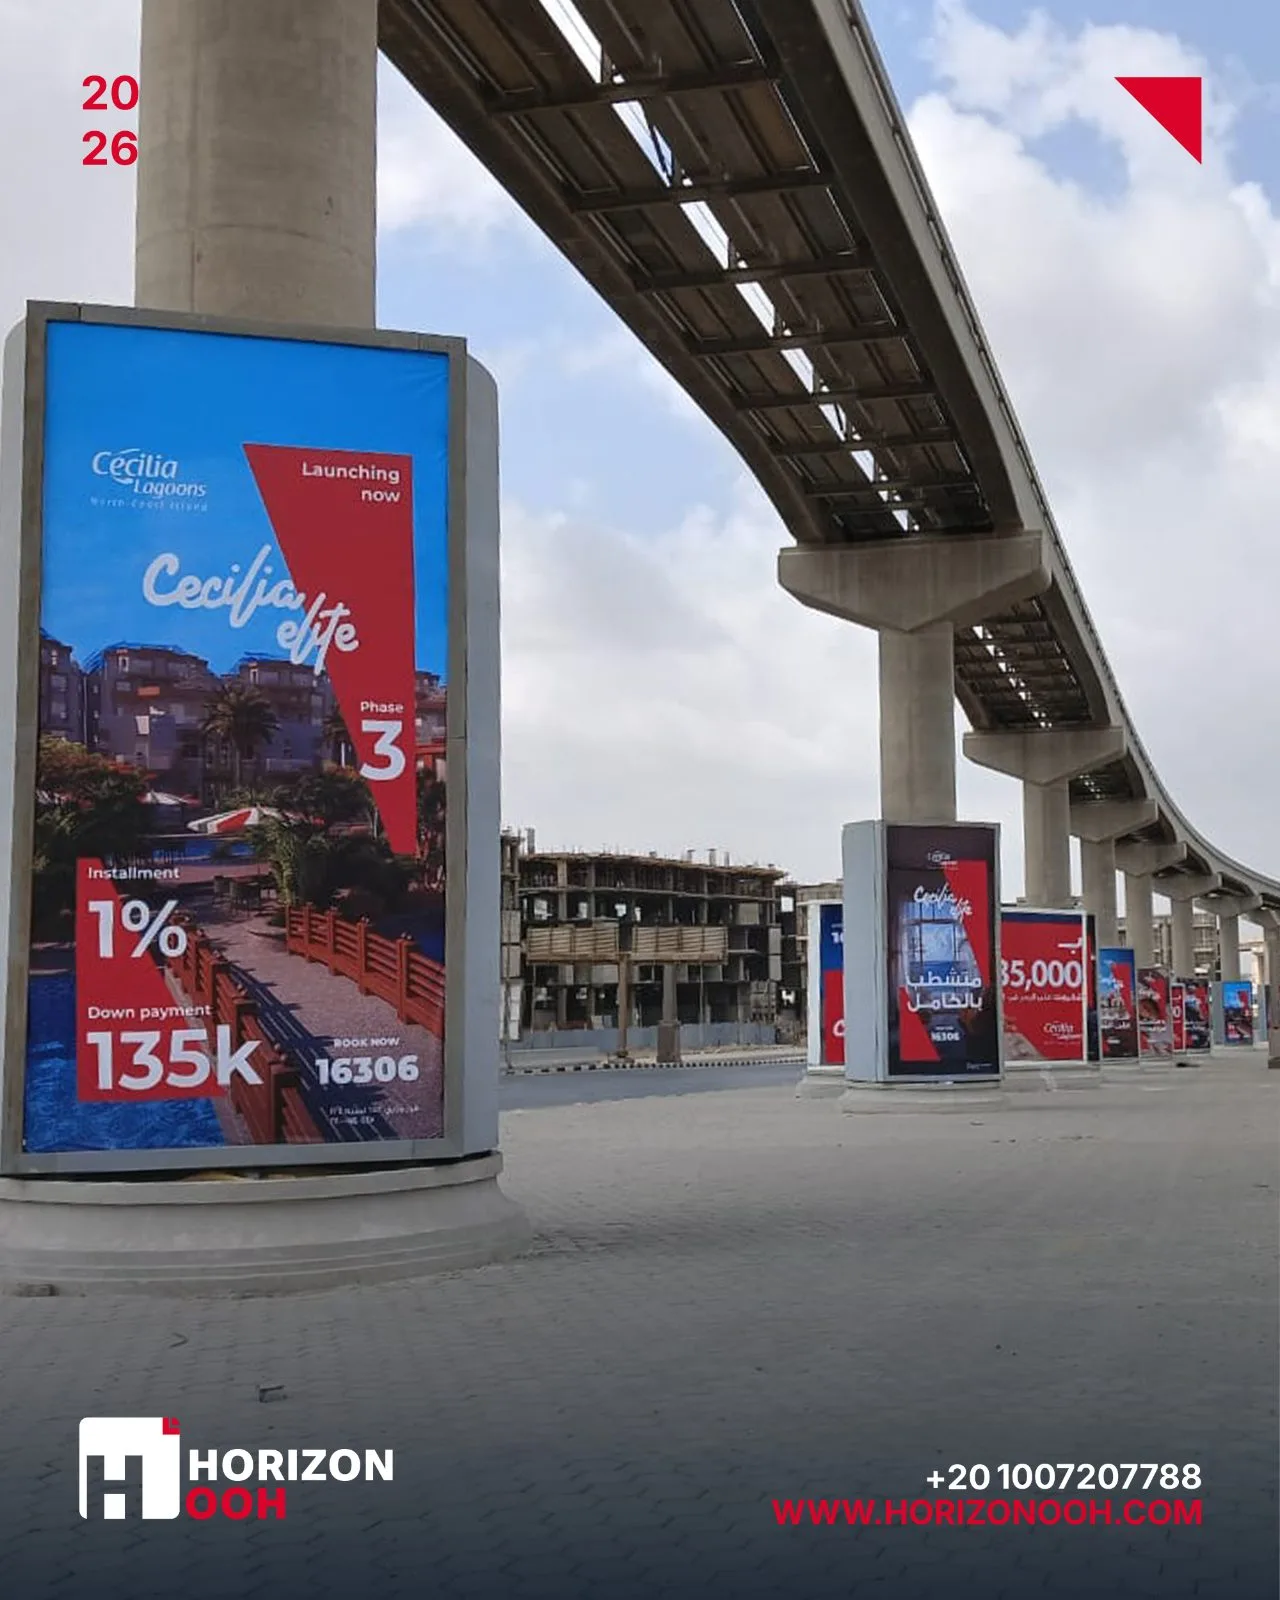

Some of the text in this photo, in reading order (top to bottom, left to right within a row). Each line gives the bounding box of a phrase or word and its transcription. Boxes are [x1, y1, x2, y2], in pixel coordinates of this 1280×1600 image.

[302, 461, 400, 485] Launching
[361, 488, 401, 502] now
[143, 544, 306, 628] Cecilia
[276, 592, 359, 676] elite
[360, 701, 404, 714] Phase
[359, 718, 406, 781] 3
[88, 866, 181, 881] Installment
[88, 899, 188, 959] 1%
[88, 1003, 212, 1022] Down payment
[907, 992, 983, 1012] بالكامل
[333, 1037, 400, 1048] BOOK NOW
[86, 1023, 264, 1091] 135k
[315, 1055, 420, 1085] 16306
